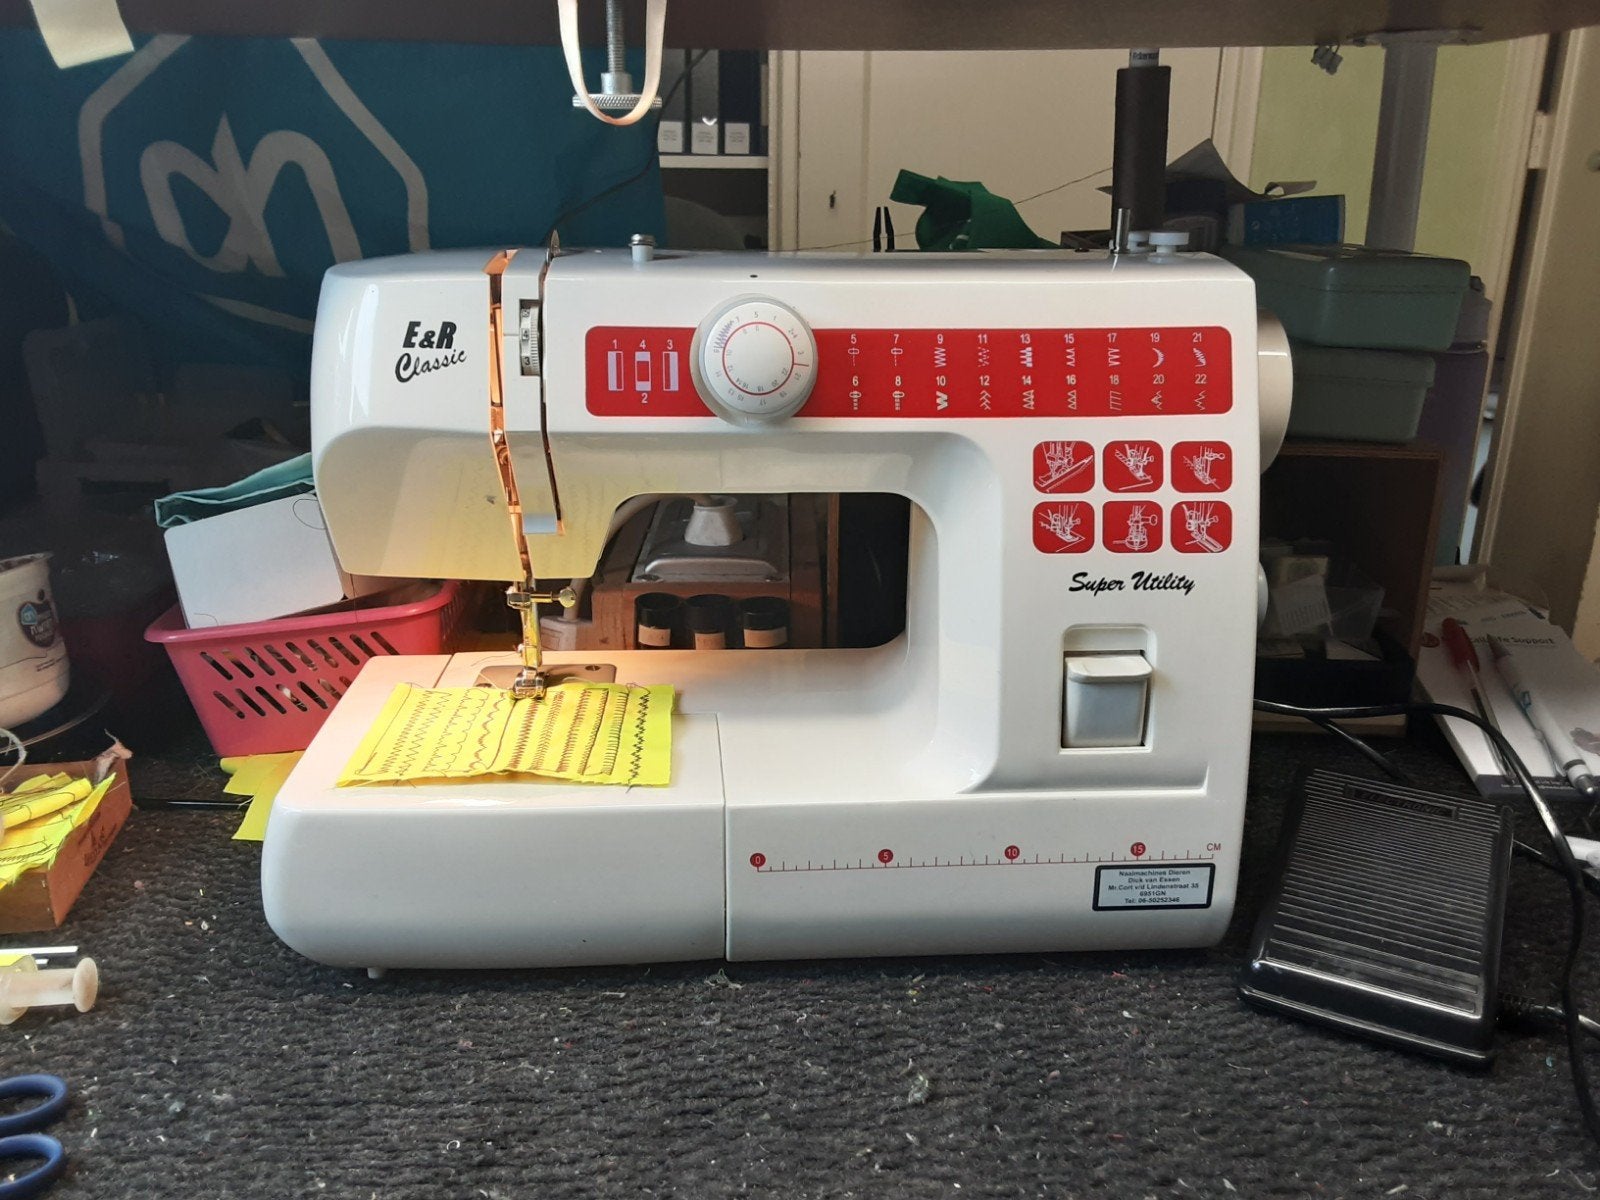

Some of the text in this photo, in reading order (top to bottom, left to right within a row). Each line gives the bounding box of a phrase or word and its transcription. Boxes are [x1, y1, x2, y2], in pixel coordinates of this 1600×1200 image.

[402, 320, 458, 349] E&R
[522, 330, 530, 341] 4
[850, 331, 1203, 345] 5 7 9 11 13 15 17 19 21
[612, 338, 674, 351] 1 4 3
[394, 348, 468, 384] Classic
[524, 356, 531, 366] 3
[852, 373, 1207, 387] 6 8 10 12 14 16 18 20 22
[641, 392, 648, 404] 2
[1068, 570, 1196, 597] Super Utility
[755, 842, 1222, 865] 0 5 10 15 CM
